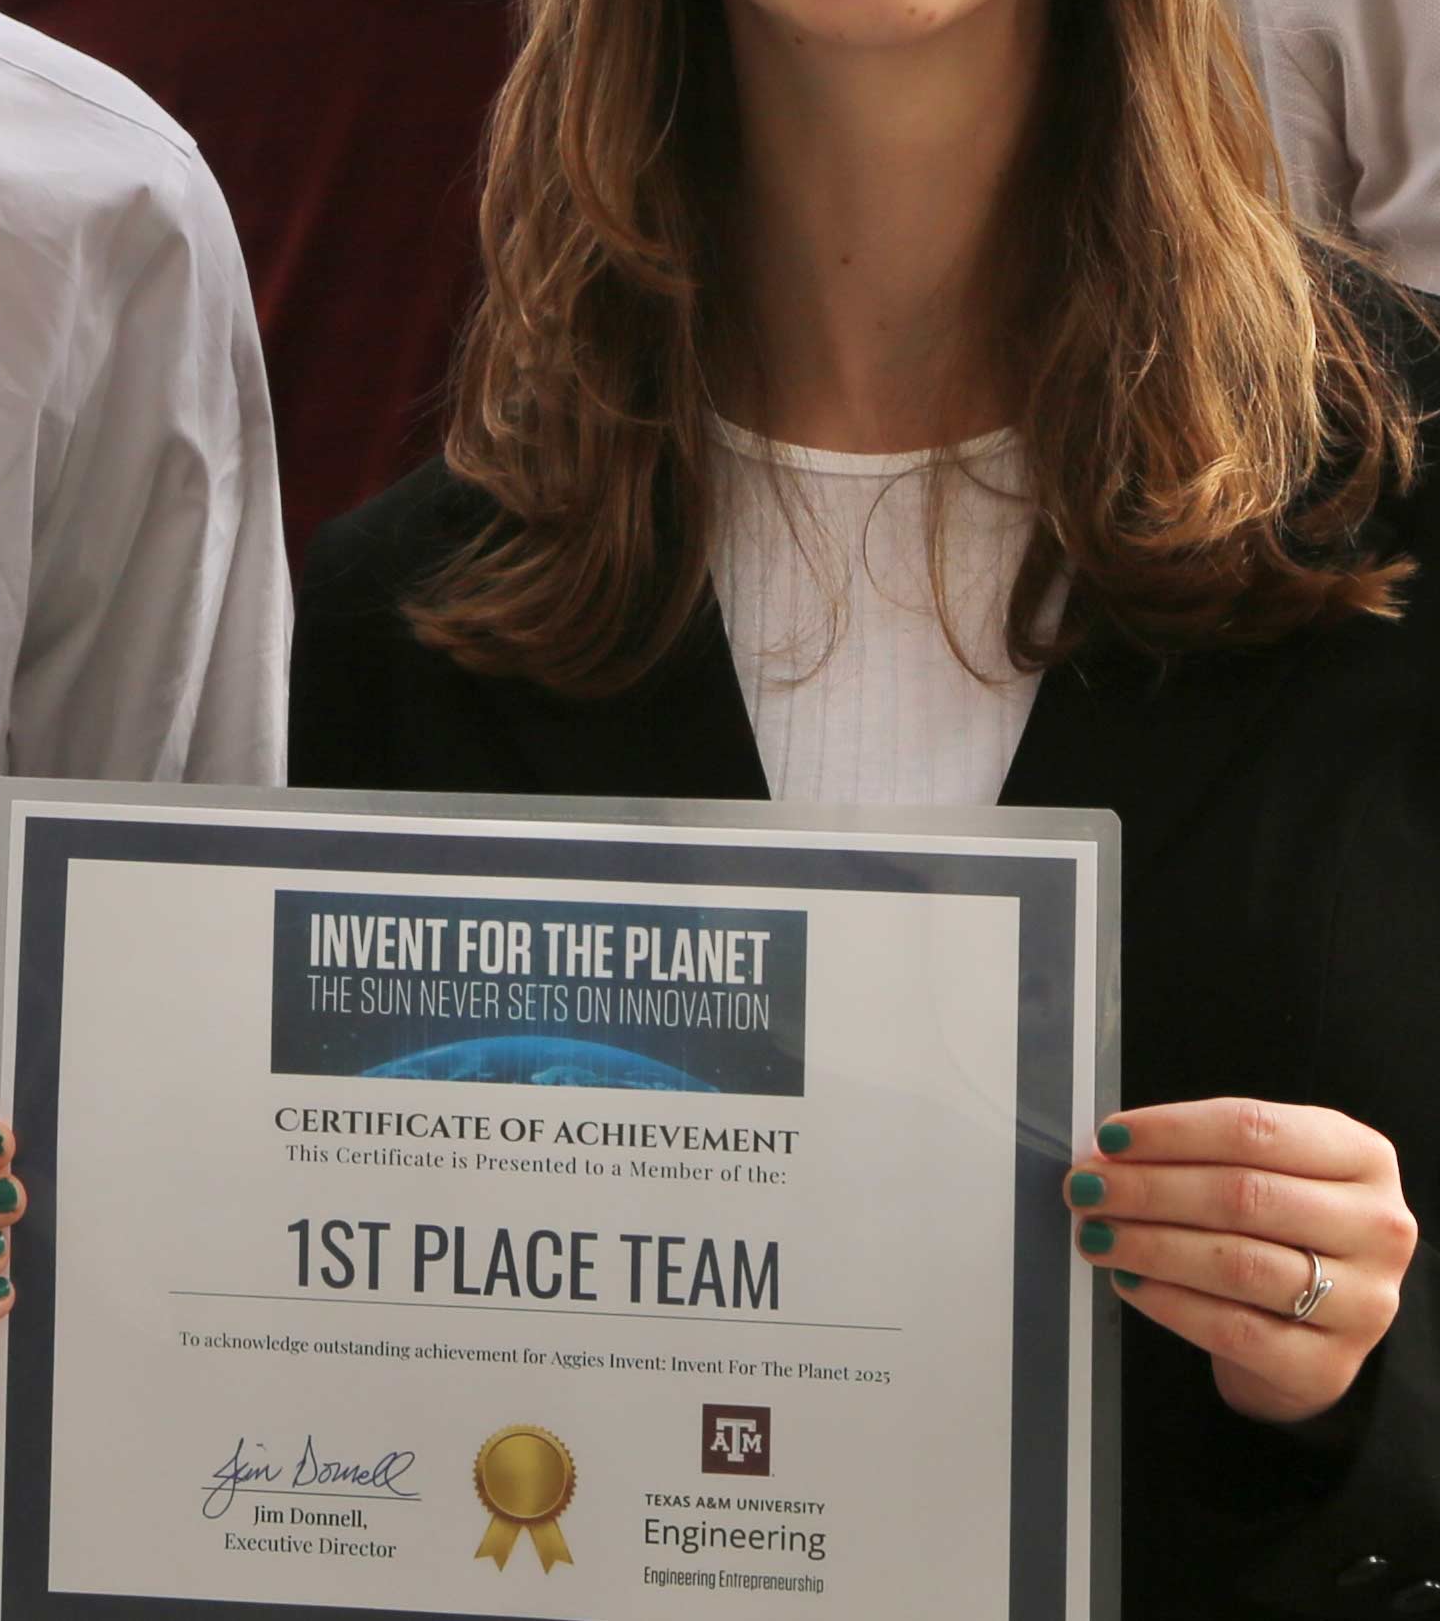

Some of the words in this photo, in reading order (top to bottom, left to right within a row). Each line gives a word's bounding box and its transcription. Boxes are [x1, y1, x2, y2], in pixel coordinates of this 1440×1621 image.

[310, 913, 449, 972] INVENT
[459, 919, 532, 976] FOR
[542, 922, 614, 979] THE
[625, 926, 772, 986] PLANET
[307, 975, 352, 1014] THE
[360, 977, 417, 1016] SUN
[420, 979, 500, 1020] NEVER
[508, 983, 570, 1023] SETS
[576, 986, 611, 1025] ON
[619, 988, 771, 1031] INNOVATION
[275, 1107, 491, 1141] CERTIFICATE
[500, 1118, 545, 1143] OF
[553, 1121, 800, 1154] ACHIEVEMENT
[286, 1145, 329, 1163] This
[336, 1146, 444, 1168] Certificate
[452, 1152, 468, 1169] is
[476, 1153, 577, 1175] Presented
[584, 1160, 604, 1175] to
[611, 1163, 621, 1176] a
[630, 1161, 713, 1181] Member
[721, 1164, 742, 1182] of
[748, 1165, 786, 1184] the:
[287, 1218, 391, 1291] 1ST
[413, 1223, 598, 1301] PLACE
[620, 1234, 780, 1311] TEAM
[179, 1331, 200, 1347] To
[204, 1332, 309, 1354] acknowledge
[313, 1338, 410, 1360] outstanding
[415, 1343, 518, 1364] achievement
[523, 1348, 547, 1365] for
[551, 1350, 605, 1369] Aggies
[609, 1352, 667, 1372] Invent:
[671, 1355, 723, 1375] Invent
[728, 1359, 757, 1376] For
[762, 1361, 793, 1378] The
[798, 1363, 850, 1381] Planet
[855, 1369, 892, 1385] 2025
[252, 1505, 284, 1526] Jim
[290, 1507, 368, 1530] Donnell,
[645, 1493, 691, 1508] TEXAS
[695, 1496, 731, 1510] A&M
[737, 1498, 826, 1515] UNIVERSITY
[224, 1532, 313, 1554] Executive
[319, 1537, 397, 1559] Director
[645, 1518, 826, 1561] Engineering
[644, 1566, 716, 1590] Engineering
[719, 1570, 825, 1594] Entrepreneurship
